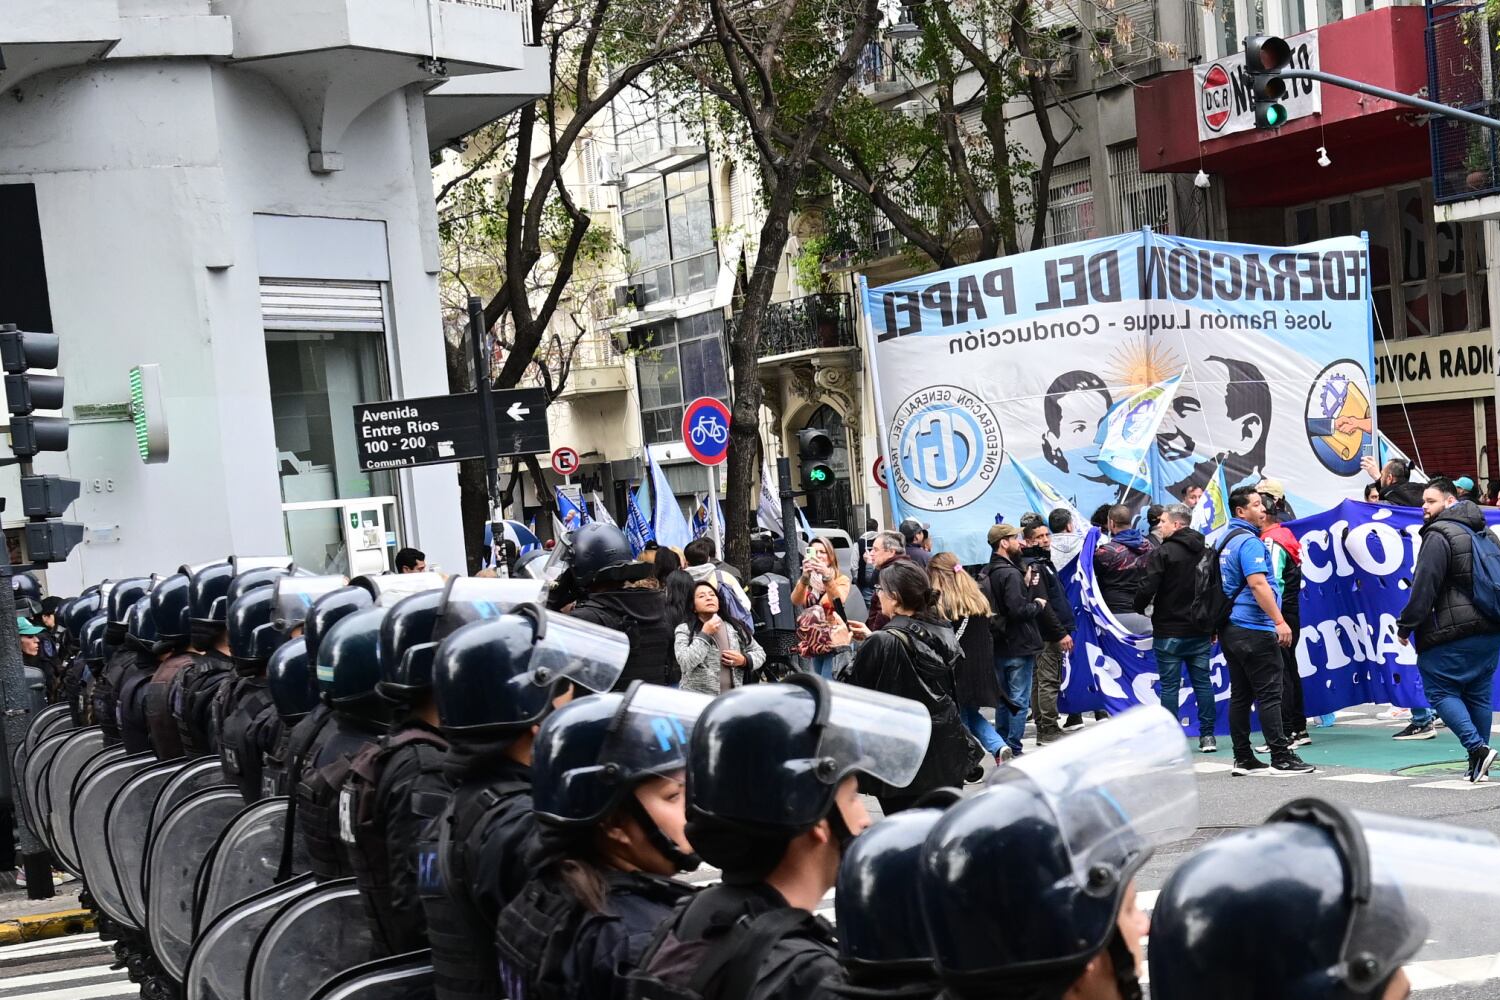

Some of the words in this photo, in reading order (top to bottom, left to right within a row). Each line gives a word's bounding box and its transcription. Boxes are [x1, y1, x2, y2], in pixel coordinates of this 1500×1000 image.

[362, 405, 419, 423] Avenida
[362, 424, 402, 438] Entre
[407, 420, 440, 434] Ríos
[364, 441, 389, 454] 100
[401, 437, 426, 450] 200
[366, 457, 408, 469] Comuna
[410, 456, 416, 464] 1
[1301, 508, 1421, 584] CIÓ
